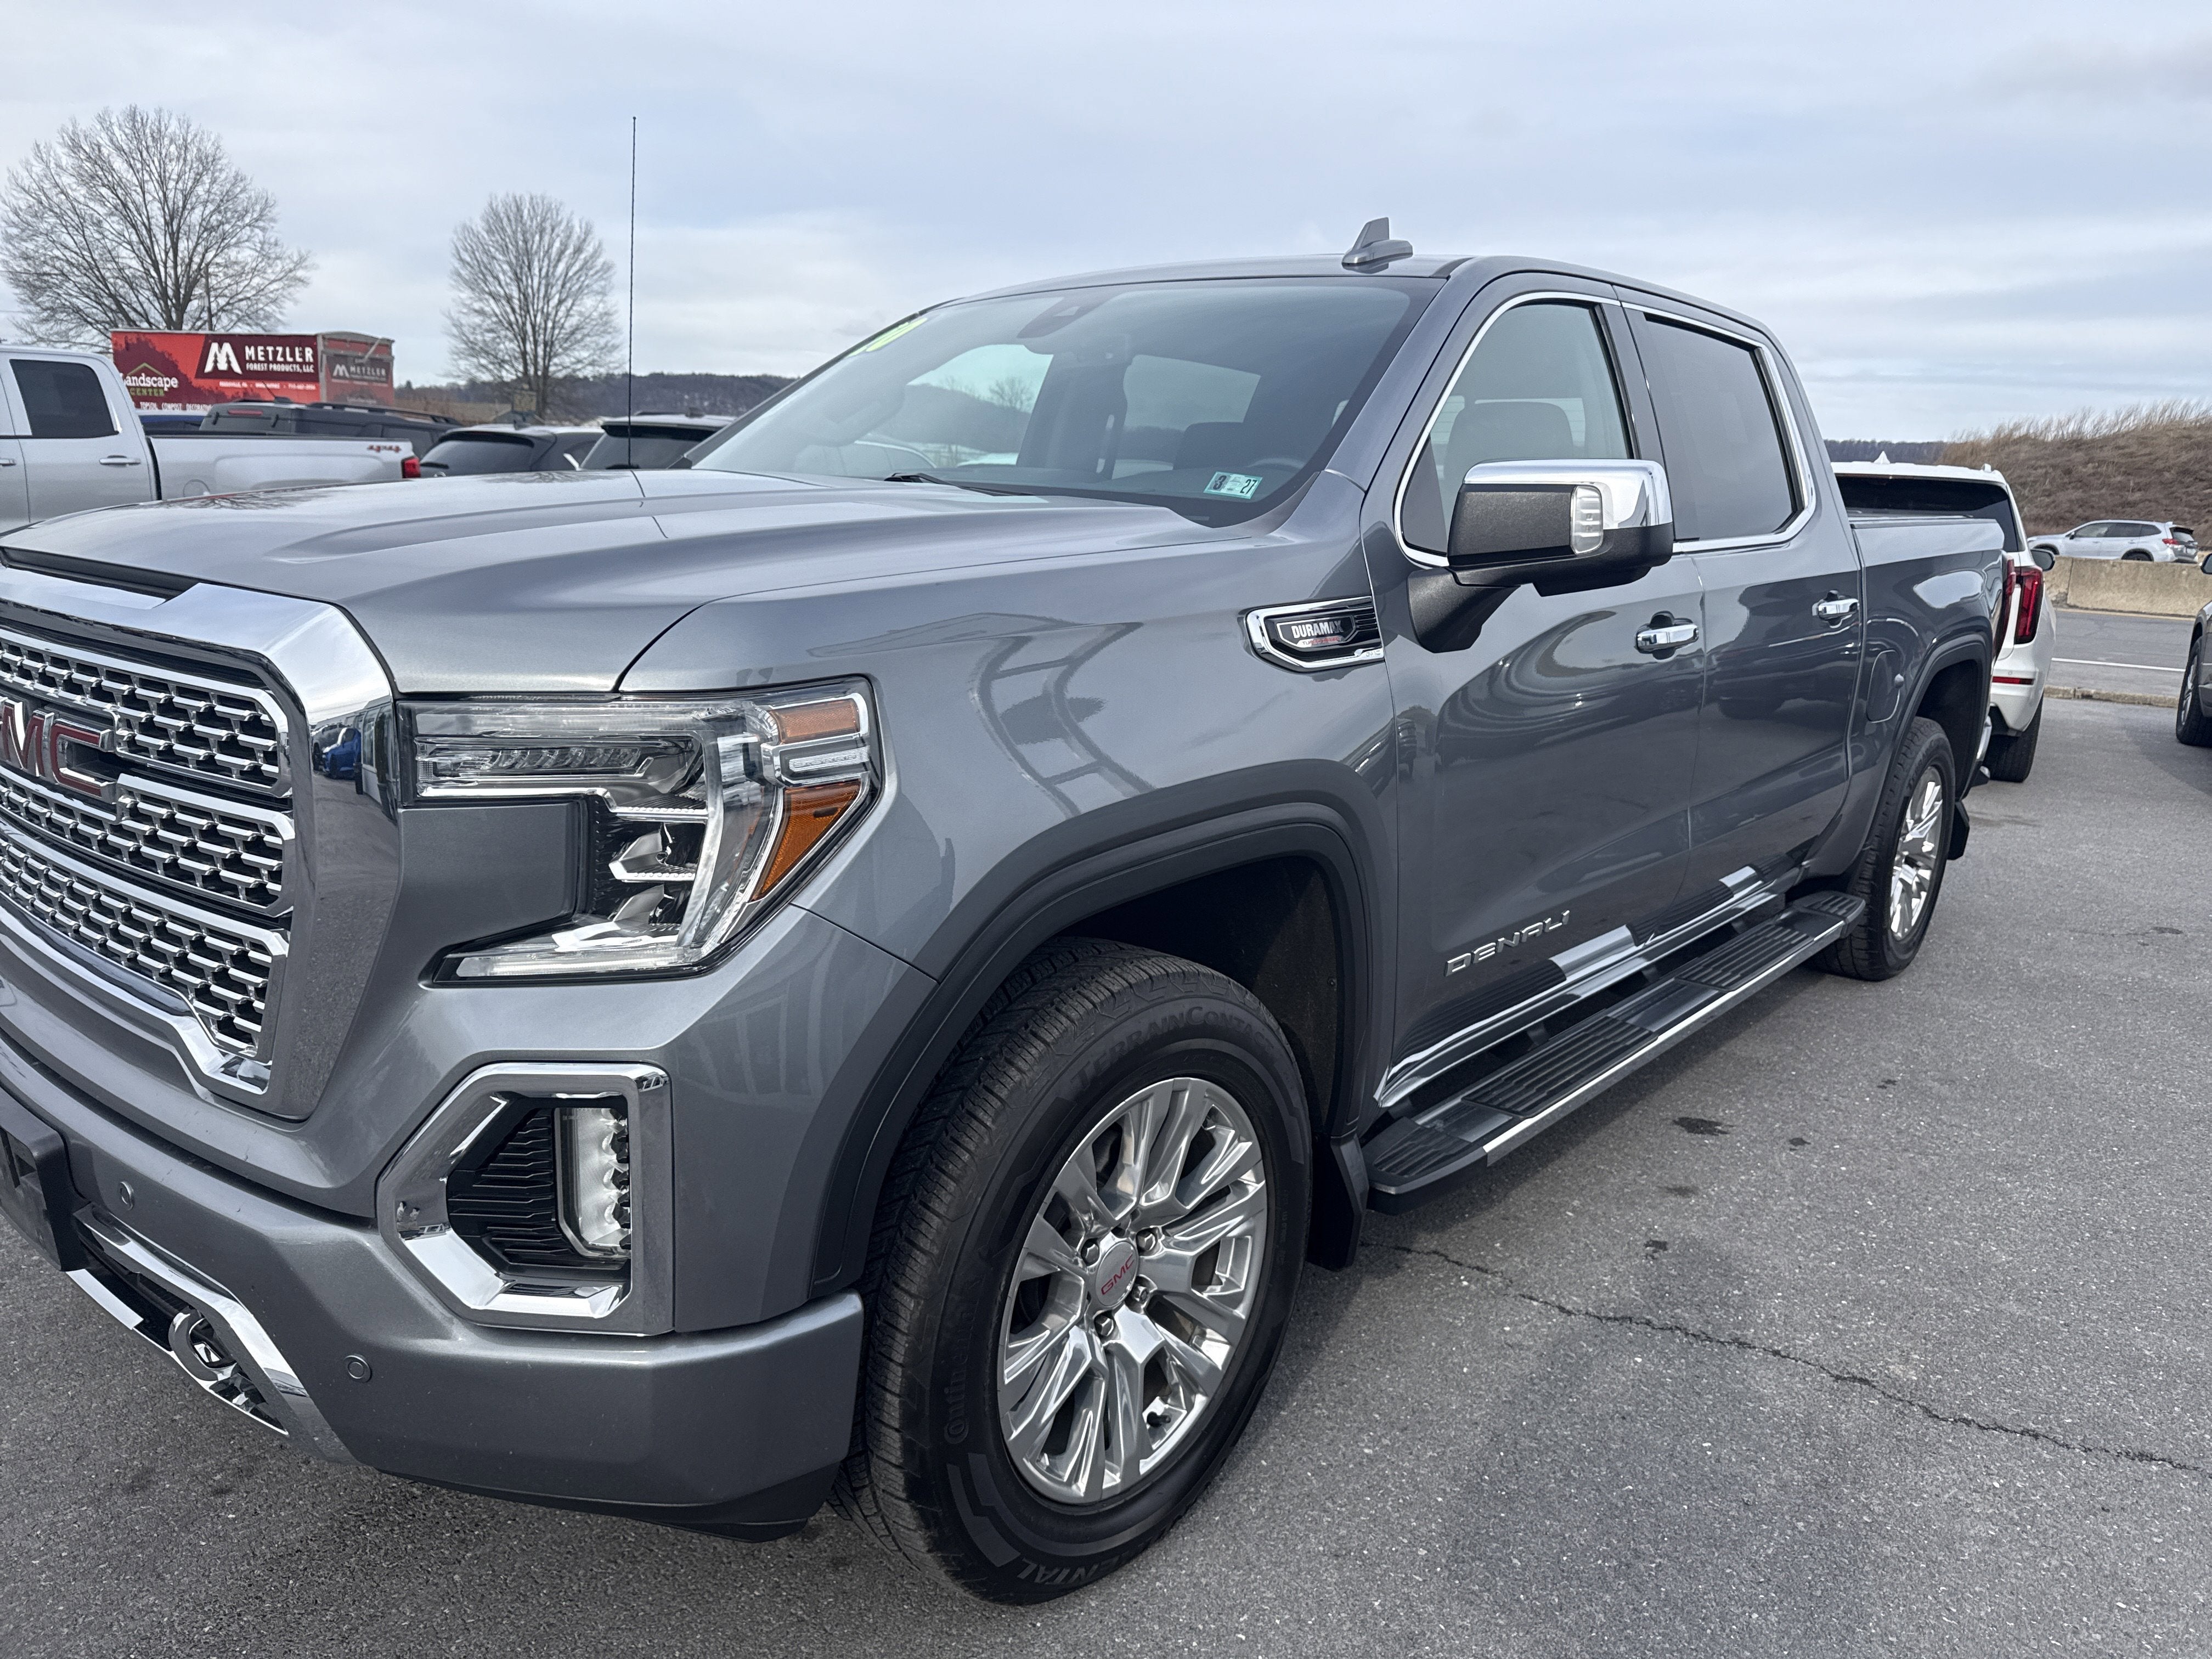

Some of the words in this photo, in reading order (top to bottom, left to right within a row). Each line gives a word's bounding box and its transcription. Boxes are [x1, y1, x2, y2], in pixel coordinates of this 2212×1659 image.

[245, 345, 314, 363] METZLER
[246, 362, 268, 371] FOREST
[303, 364, 315, 374] LLC
[129, 387, 165, 398] CENTER
[1212, 475, 1227, 490] 3
[1239, 479, 1257, 494] 27
[1291, 620, 1344, 639] DURAMAX
[0, 696, 117, 804] MC
[1444, 910, 1570, 978] DENALI
[1100, 1251, 1135, 1296] GMC
